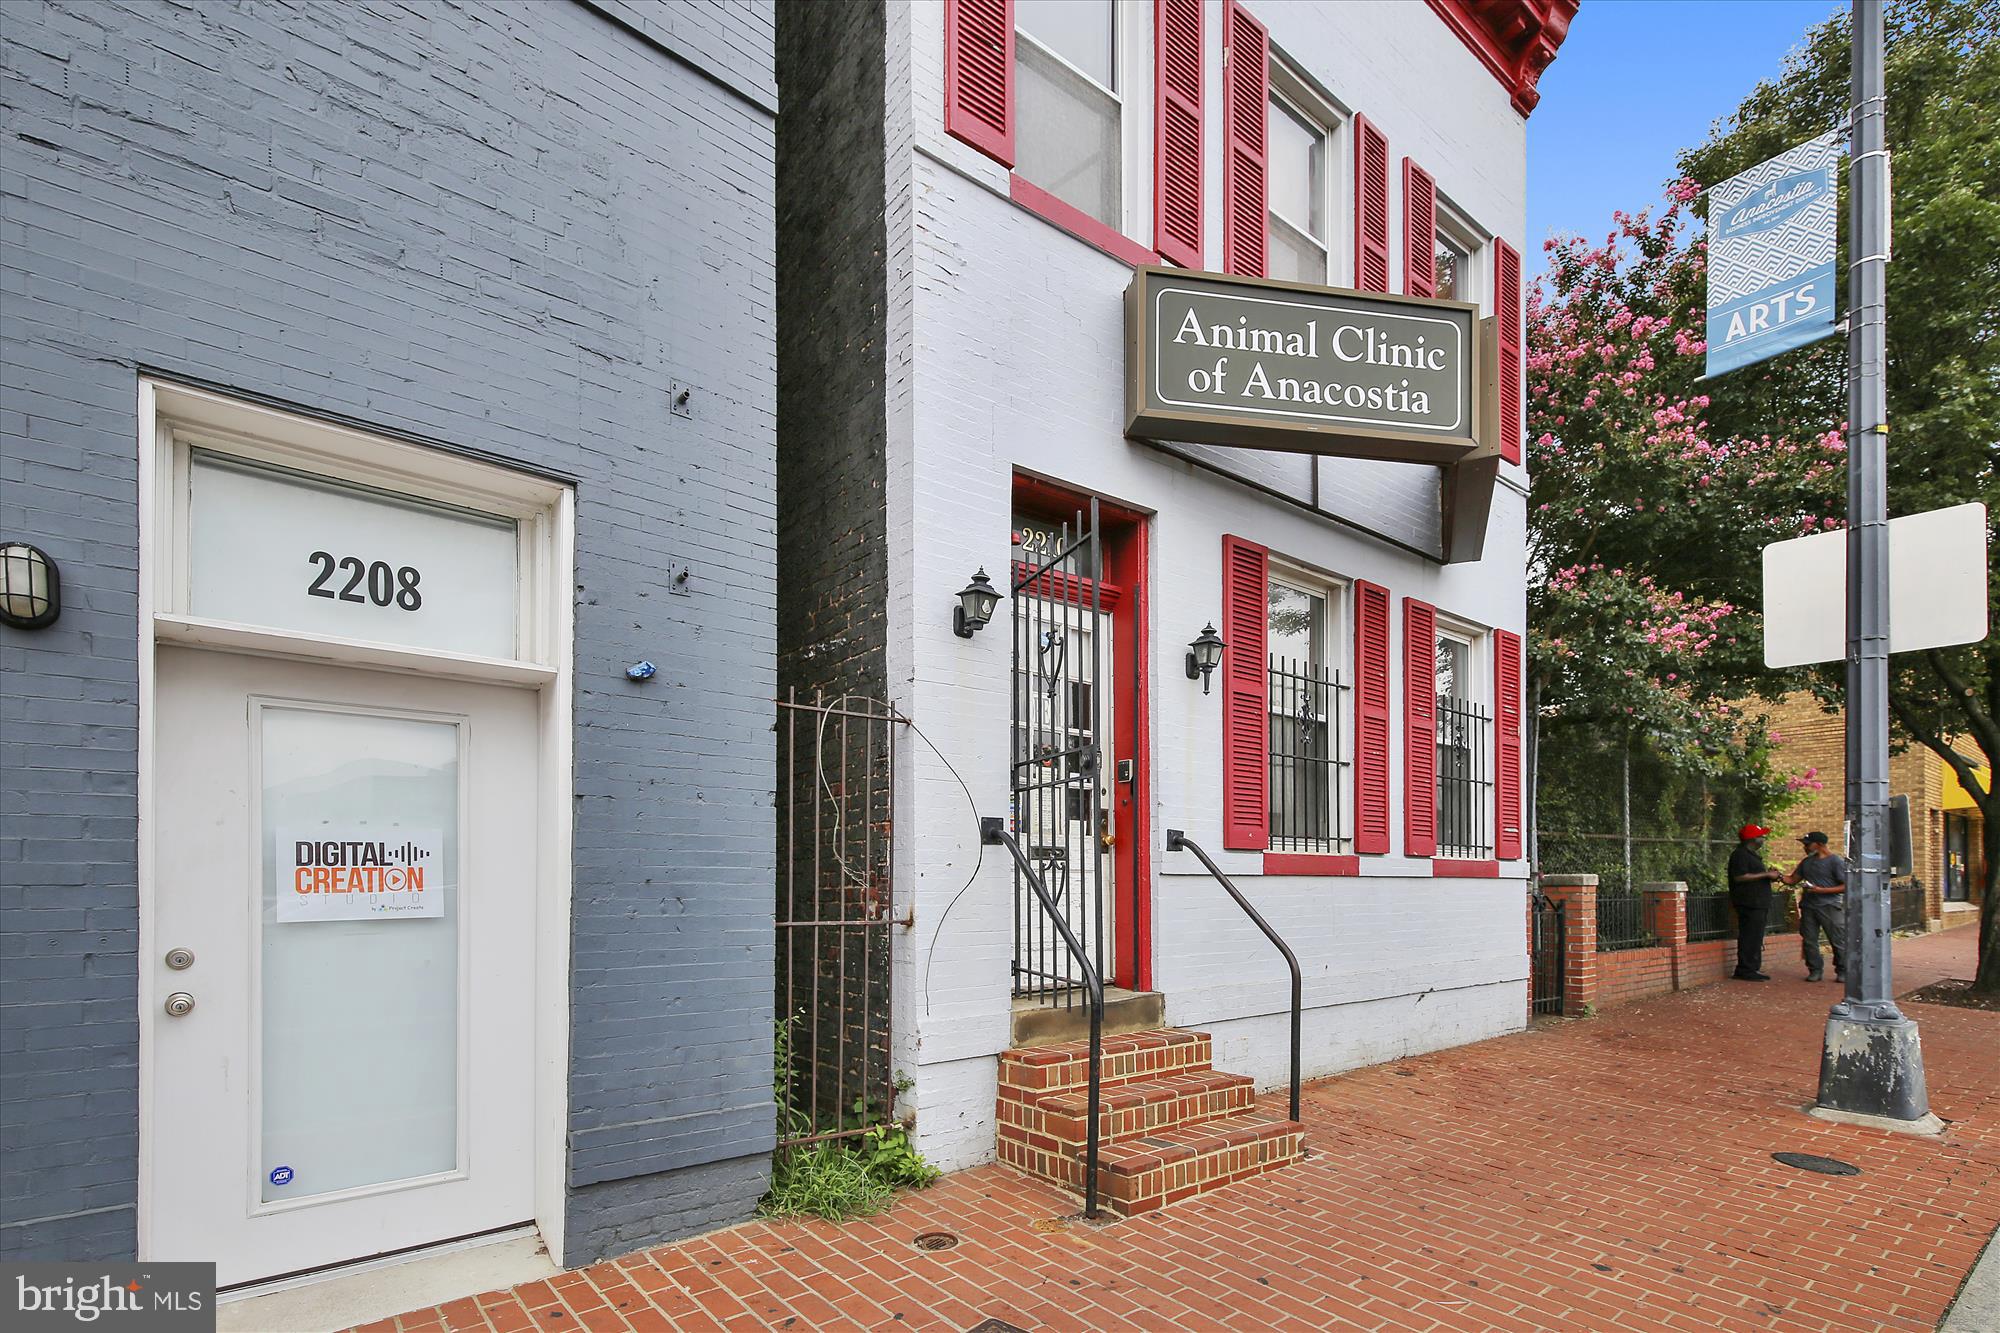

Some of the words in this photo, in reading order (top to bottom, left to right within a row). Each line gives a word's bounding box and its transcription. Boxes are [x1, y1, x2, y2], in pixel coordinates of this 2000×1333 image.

[1731, 181, 1815, 226] Anacostia
[1725, 284, 1816, 342] ARTS
[1173, 307, 1319, 358] Animal
[1332, 325, 1446, 371] Clinic
[1188, 357, 1228, 395] of
[1241, 361, 1431, 415] Anacostia
[308, 551, 422, 611] 2208
[295, 841, 393, 866] DIGITAL
[295, 867, 424, 894] CREATION
[299, 892, 420, 906] STUDIO
[273, 1171, 290, 1180] ADT
